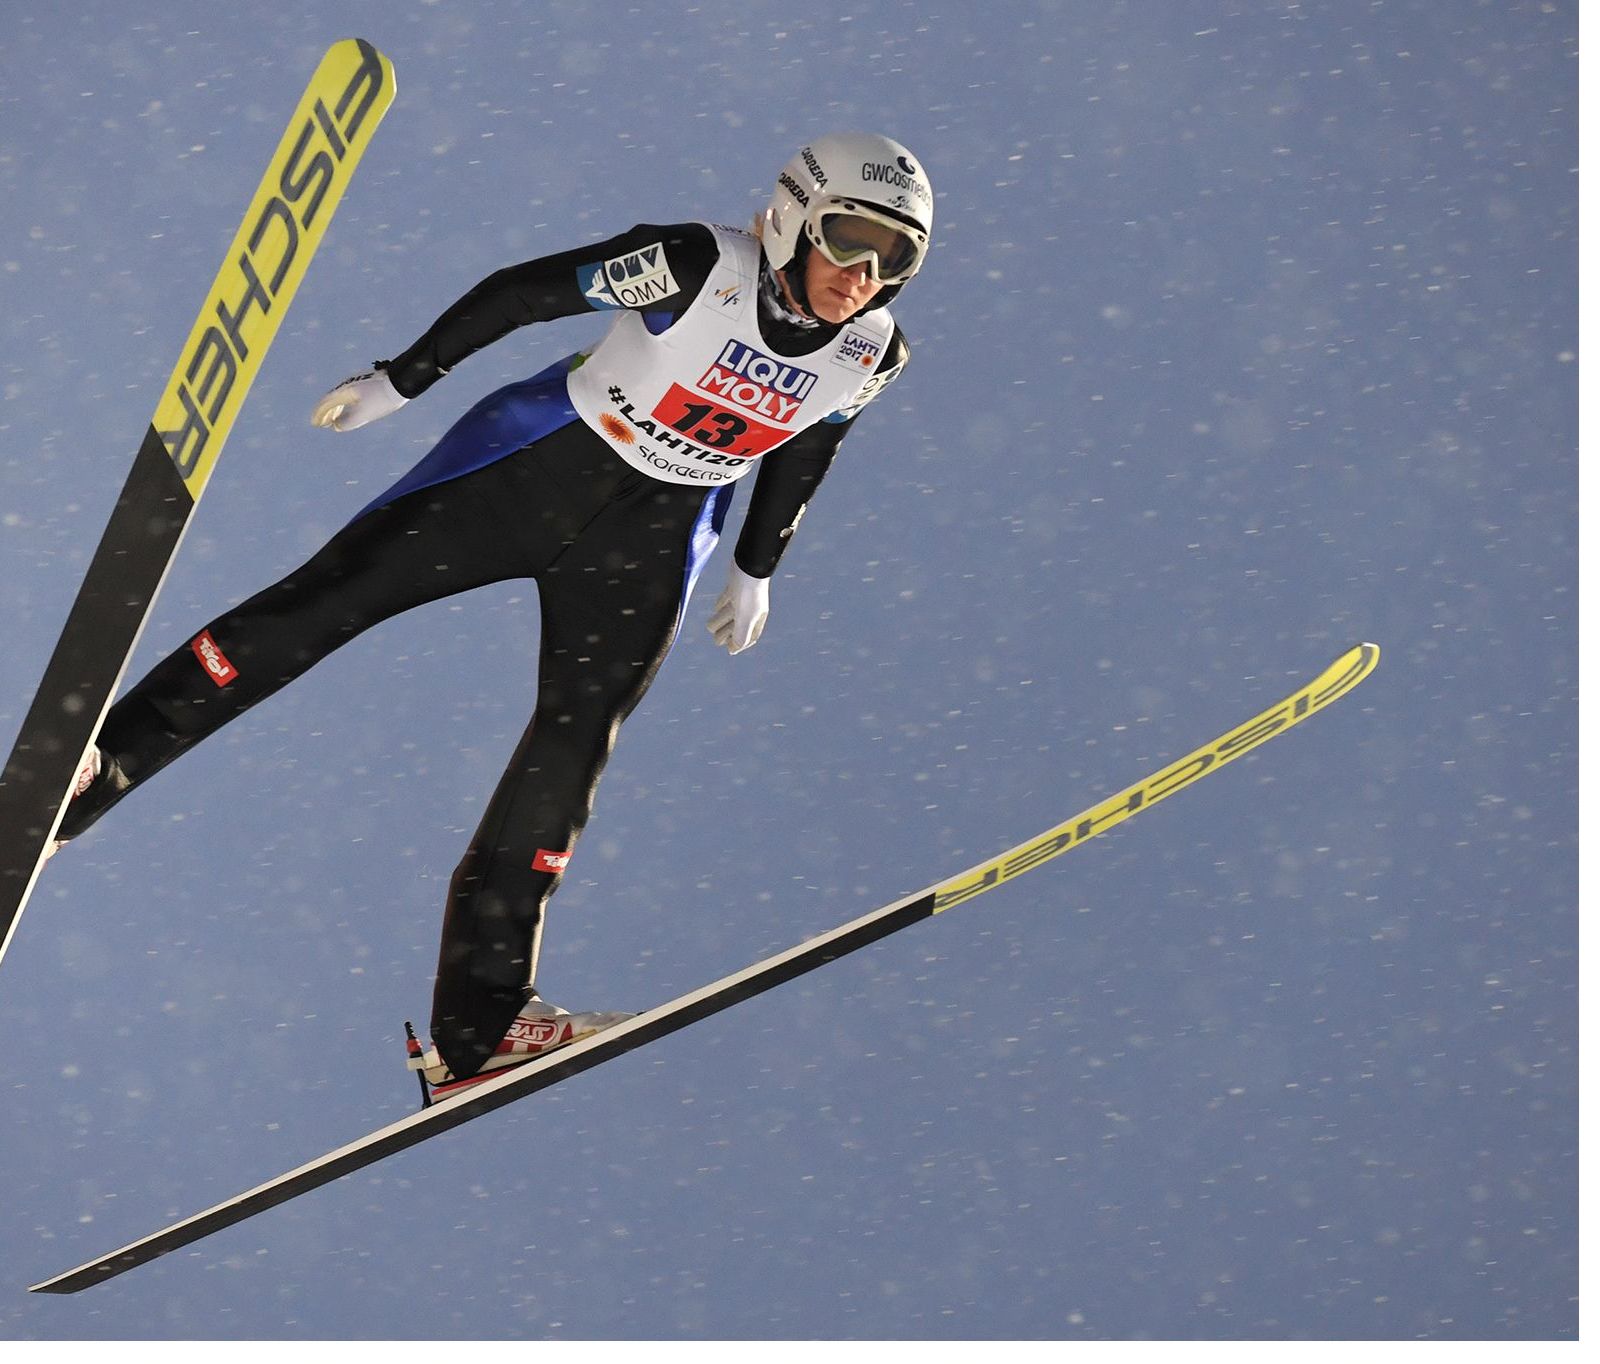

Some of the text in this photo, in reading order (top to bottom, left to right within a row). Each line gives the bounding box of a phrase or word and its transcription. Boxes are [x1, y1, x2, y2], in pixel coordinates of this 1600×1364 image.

[157, 38, 383, 480] FISCHER
[620, 274, 669, 305] OMV
[840, 345, 862, 361] 2017
[844, 334, 879, 357] LAHTI
[719, 343, 815, 399] LIQUI
[700, 372, 799, 422] MOLY
[608, 386, 753, 466] #LAHTI20
[672, 401, 747, 448] 13
[933, 644, 1374, 909] FISCHER
